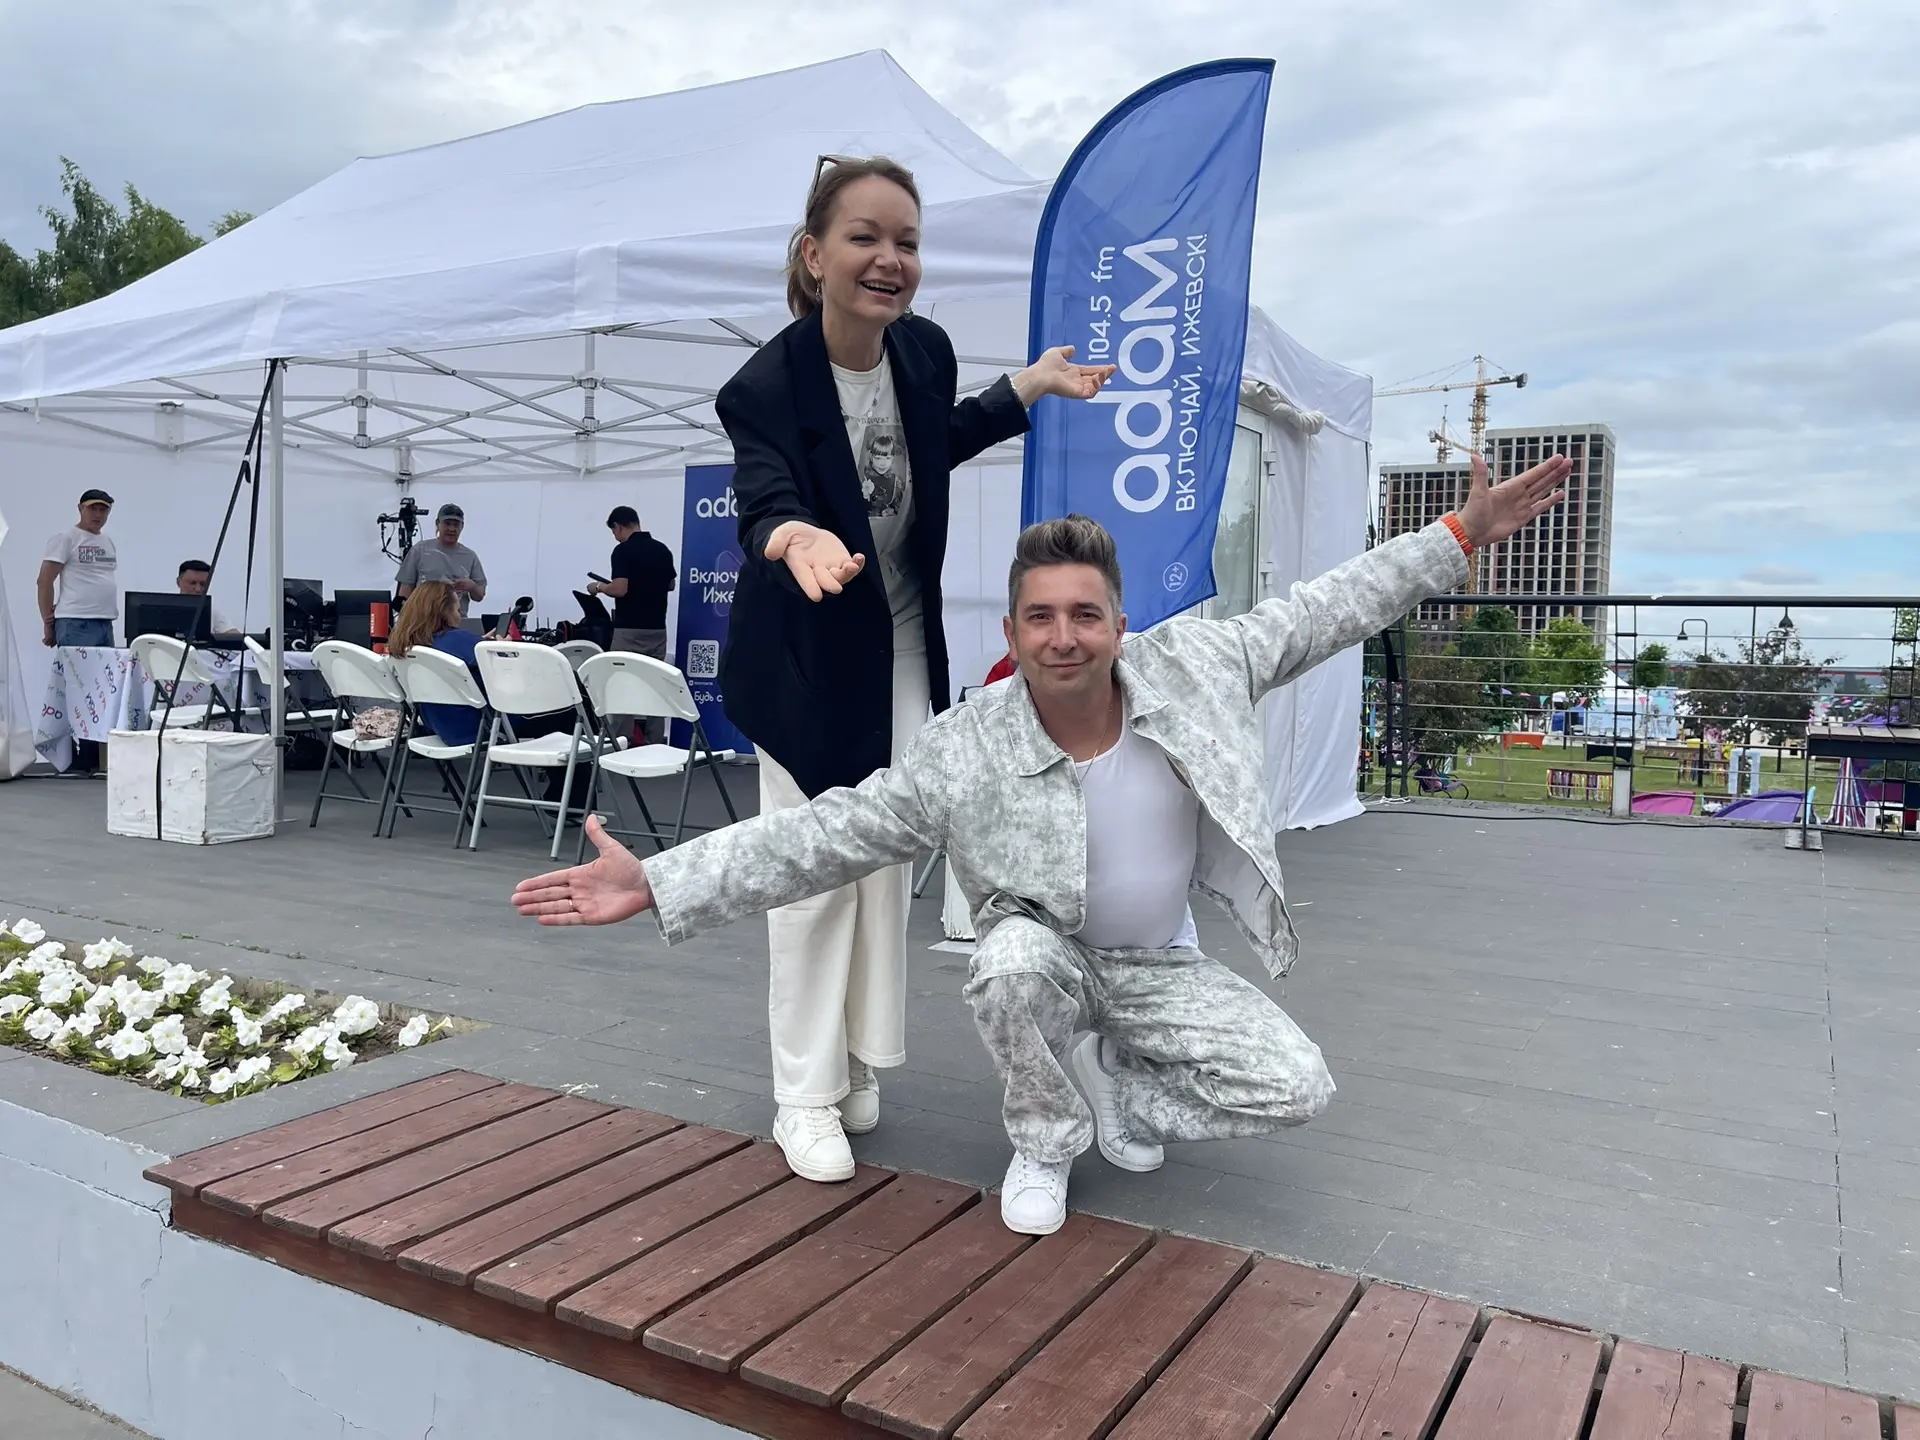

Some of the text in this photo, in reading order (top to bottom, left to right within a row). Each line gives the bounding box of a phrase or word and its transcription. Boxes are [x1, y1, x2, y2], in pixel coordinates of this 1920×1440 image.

[1088, 246, 1116, 361] 104.5 fm
[1173, 233, 1208, 512] ВКЛЮЧАЙ, ИЖЕВСК!
[689, 567, 739, 584] Включ
[1169, 565, 1184, 588] 12+
[703, 586, 735, 604] Иже
